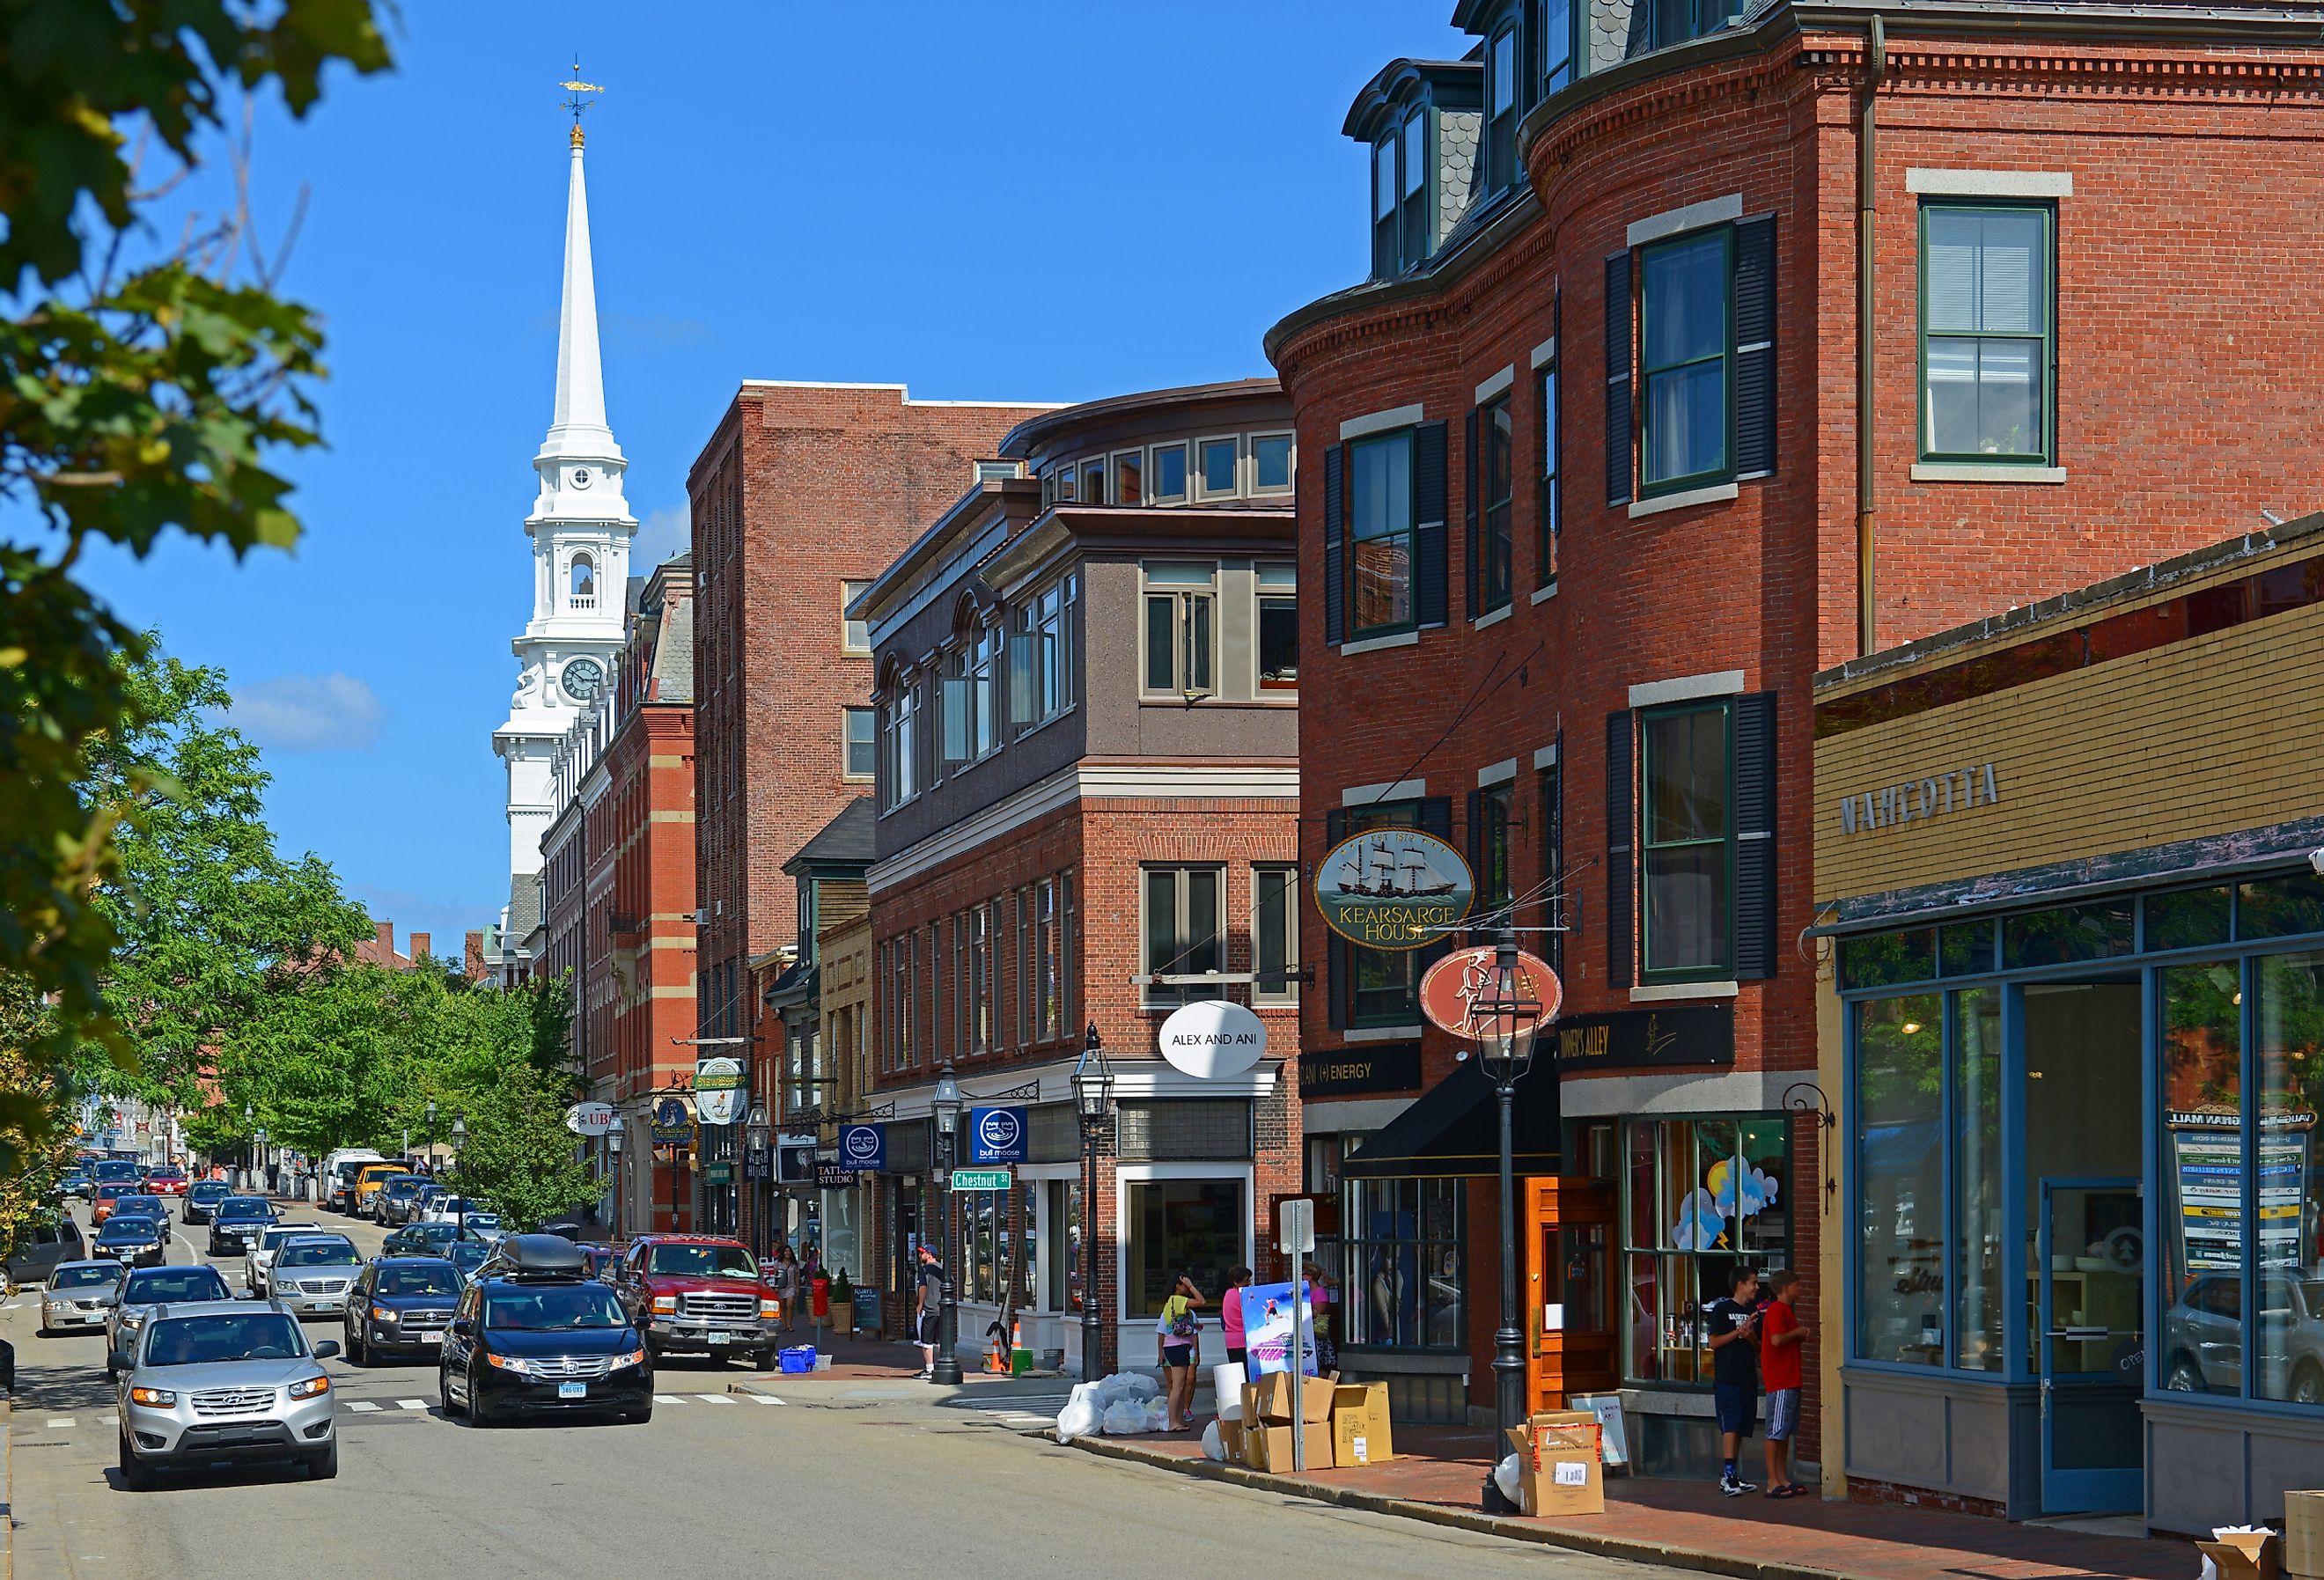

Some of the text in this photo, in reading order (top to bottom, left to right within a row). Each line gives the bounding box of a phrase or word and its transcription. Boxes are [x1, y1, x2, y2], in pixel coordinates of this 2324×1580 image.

[1841, 764, 1997, 835] NAHCOTTA
[1371, 833, 1388, 841] EST
[1339, 907, 1455, 923] KEARSARGE
[1365, 924, 1429, 941] HOUSE
[1172, 1033, 1257, 1046] ALEX AND ANI
[1585, 1025, 1609, 1056] ALLEY
[1330, 1062, 1372, 1080] ENERGY
[819, 1175, 854, 1184] STUDIO
[955, 1173, 1008, 1187] Chestnut St
